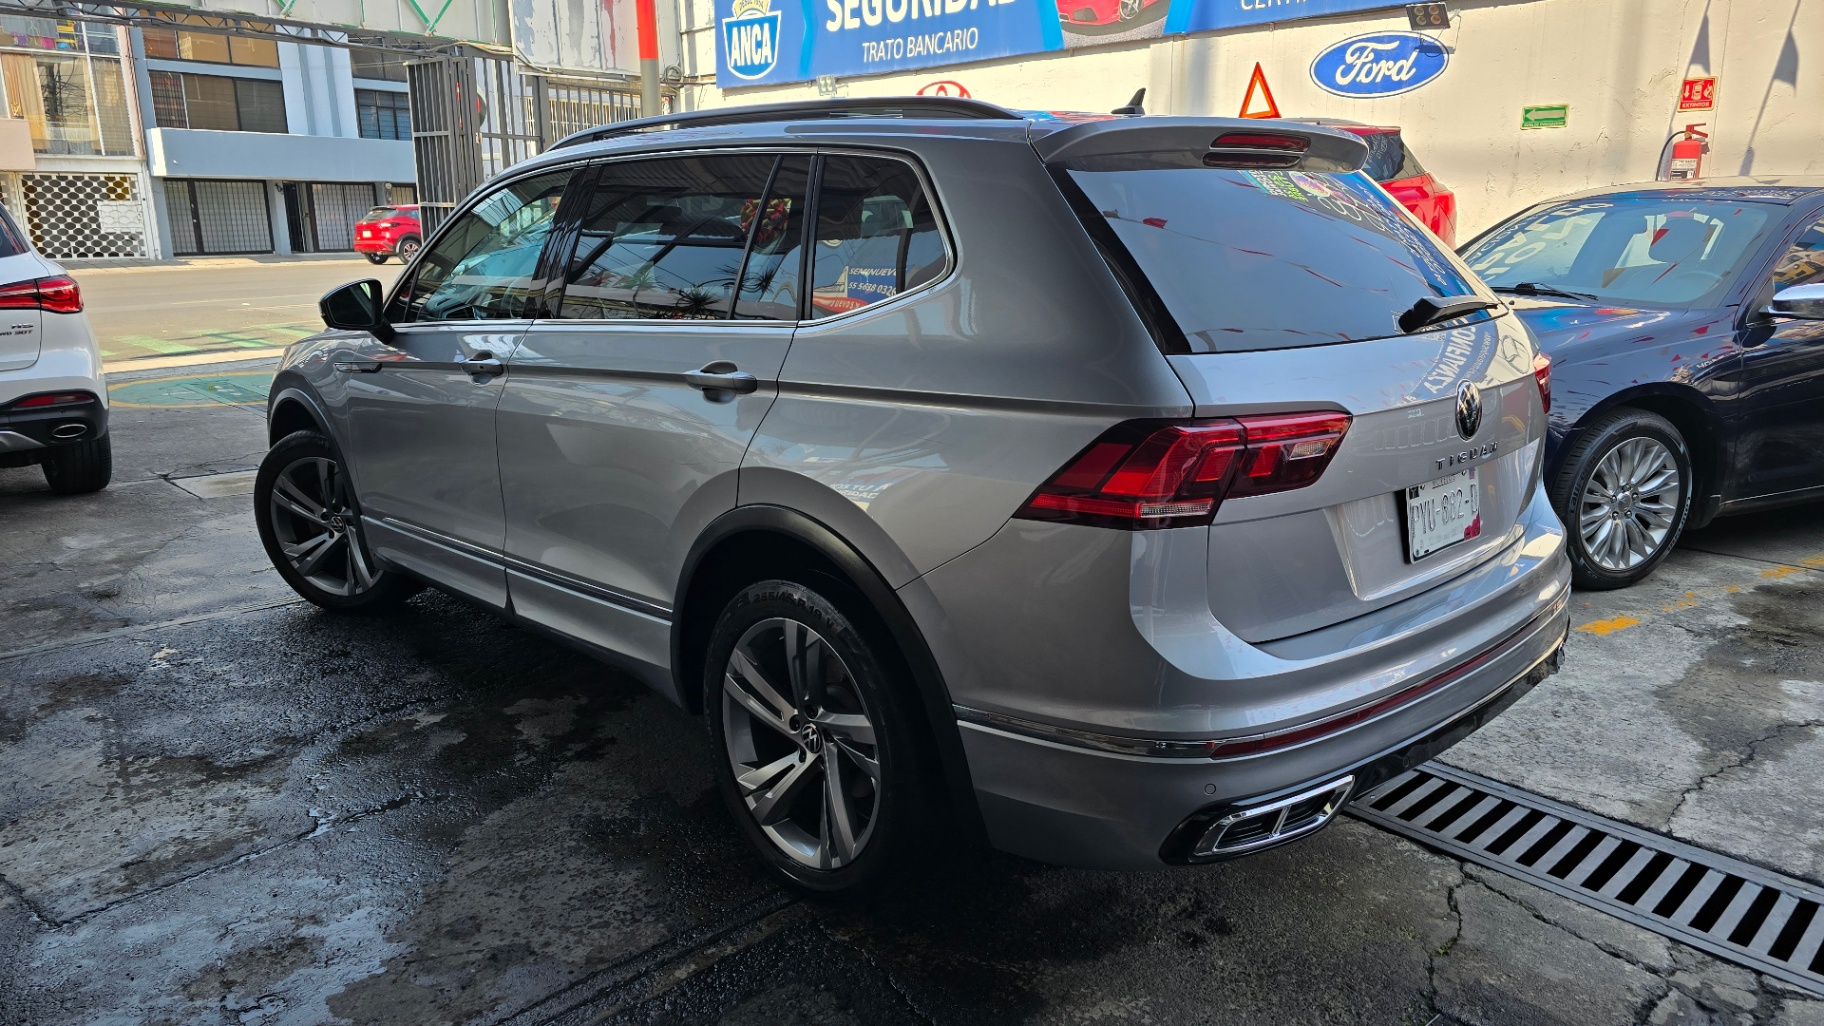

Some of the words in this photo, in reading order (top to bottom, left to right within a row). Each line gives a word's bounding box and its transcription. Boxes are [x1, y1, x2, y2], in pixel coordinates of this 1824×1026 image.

[731, 23, 772, 67] ANCA
[862, 38, 903, 63] TRATO
[907, 27, 978, 58] BANCARIO
[1336, 41, 1419, 86] Ford
[1435, 442, 1498, 470] TIGUAN
[809, 605, 823, 619] 19
